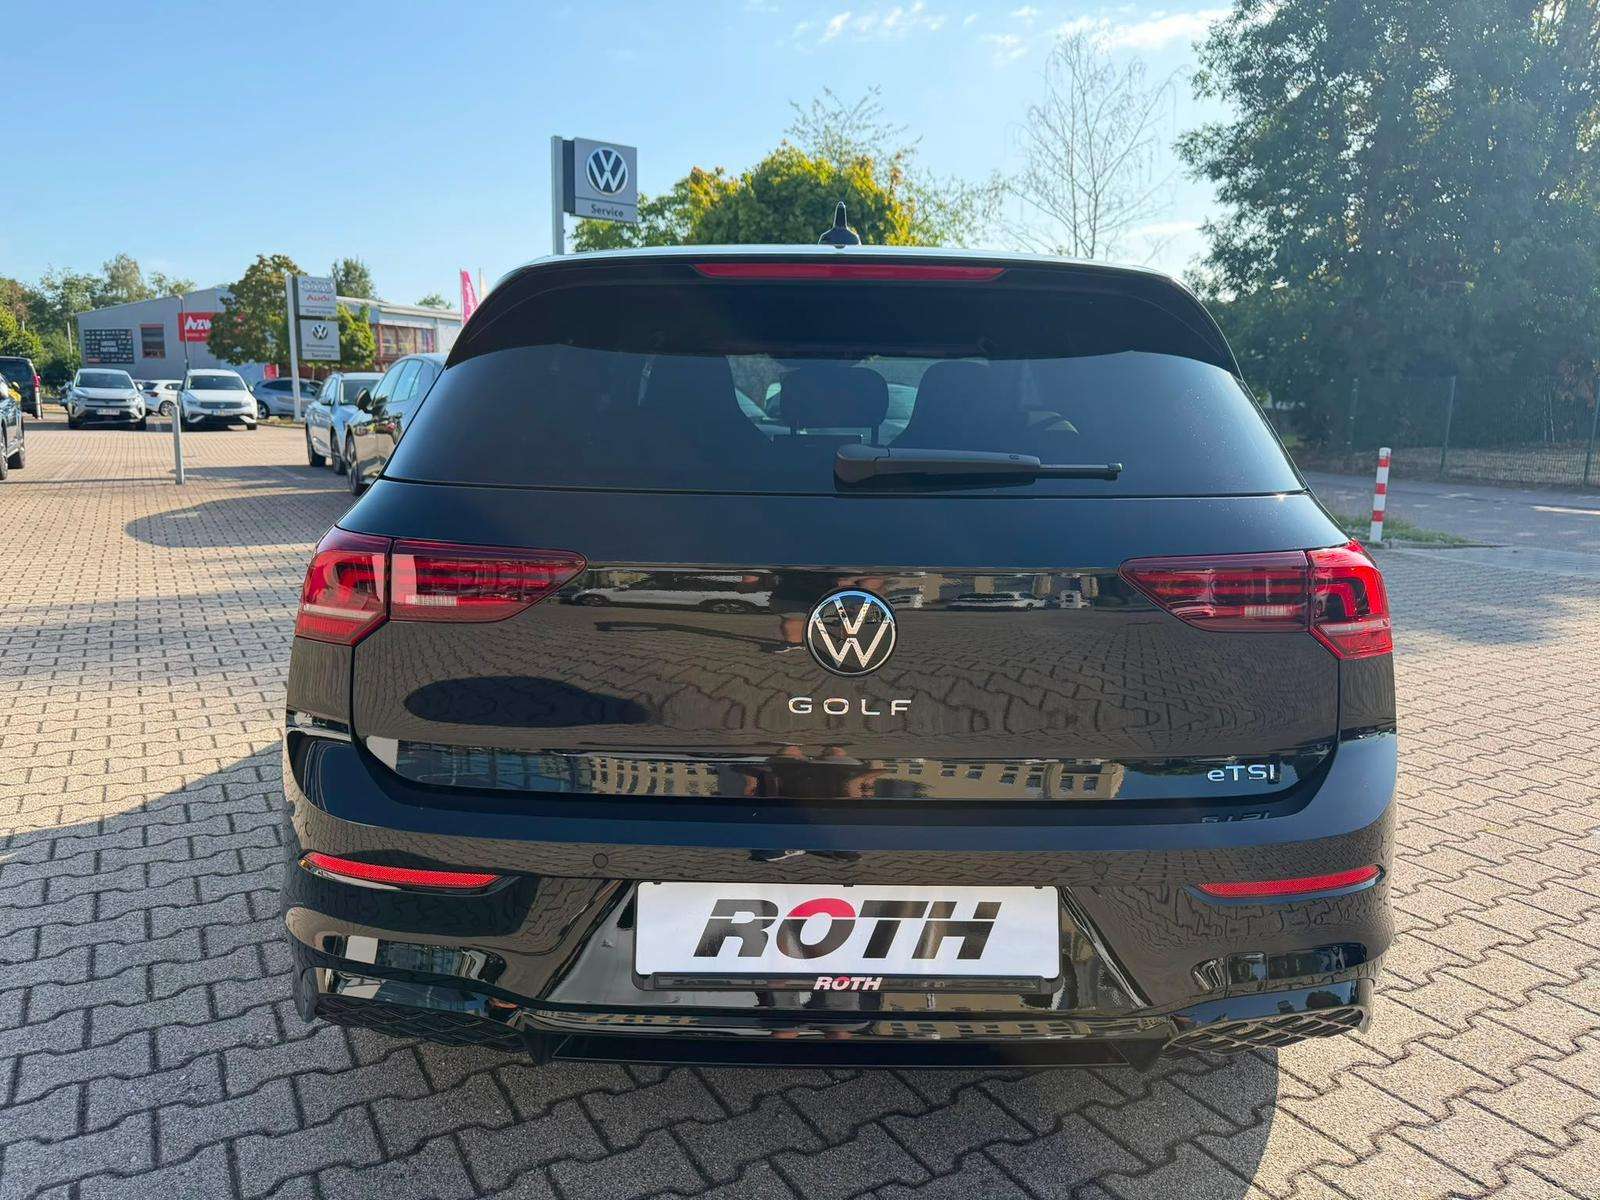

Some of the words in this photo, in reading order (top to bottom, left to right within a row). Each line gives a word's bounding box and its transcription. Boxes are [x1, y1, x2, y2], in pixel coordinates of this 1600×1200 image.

[591, 203, 624, 218] Service
[306, 294, 330, 302] Audi
[788, 696, 912, 716] GOLF
[1207, 763, 1275, 782] eTSI
[693, 897, 1002, 960] ROTH
[813, 975, 883, 992] ROTH
